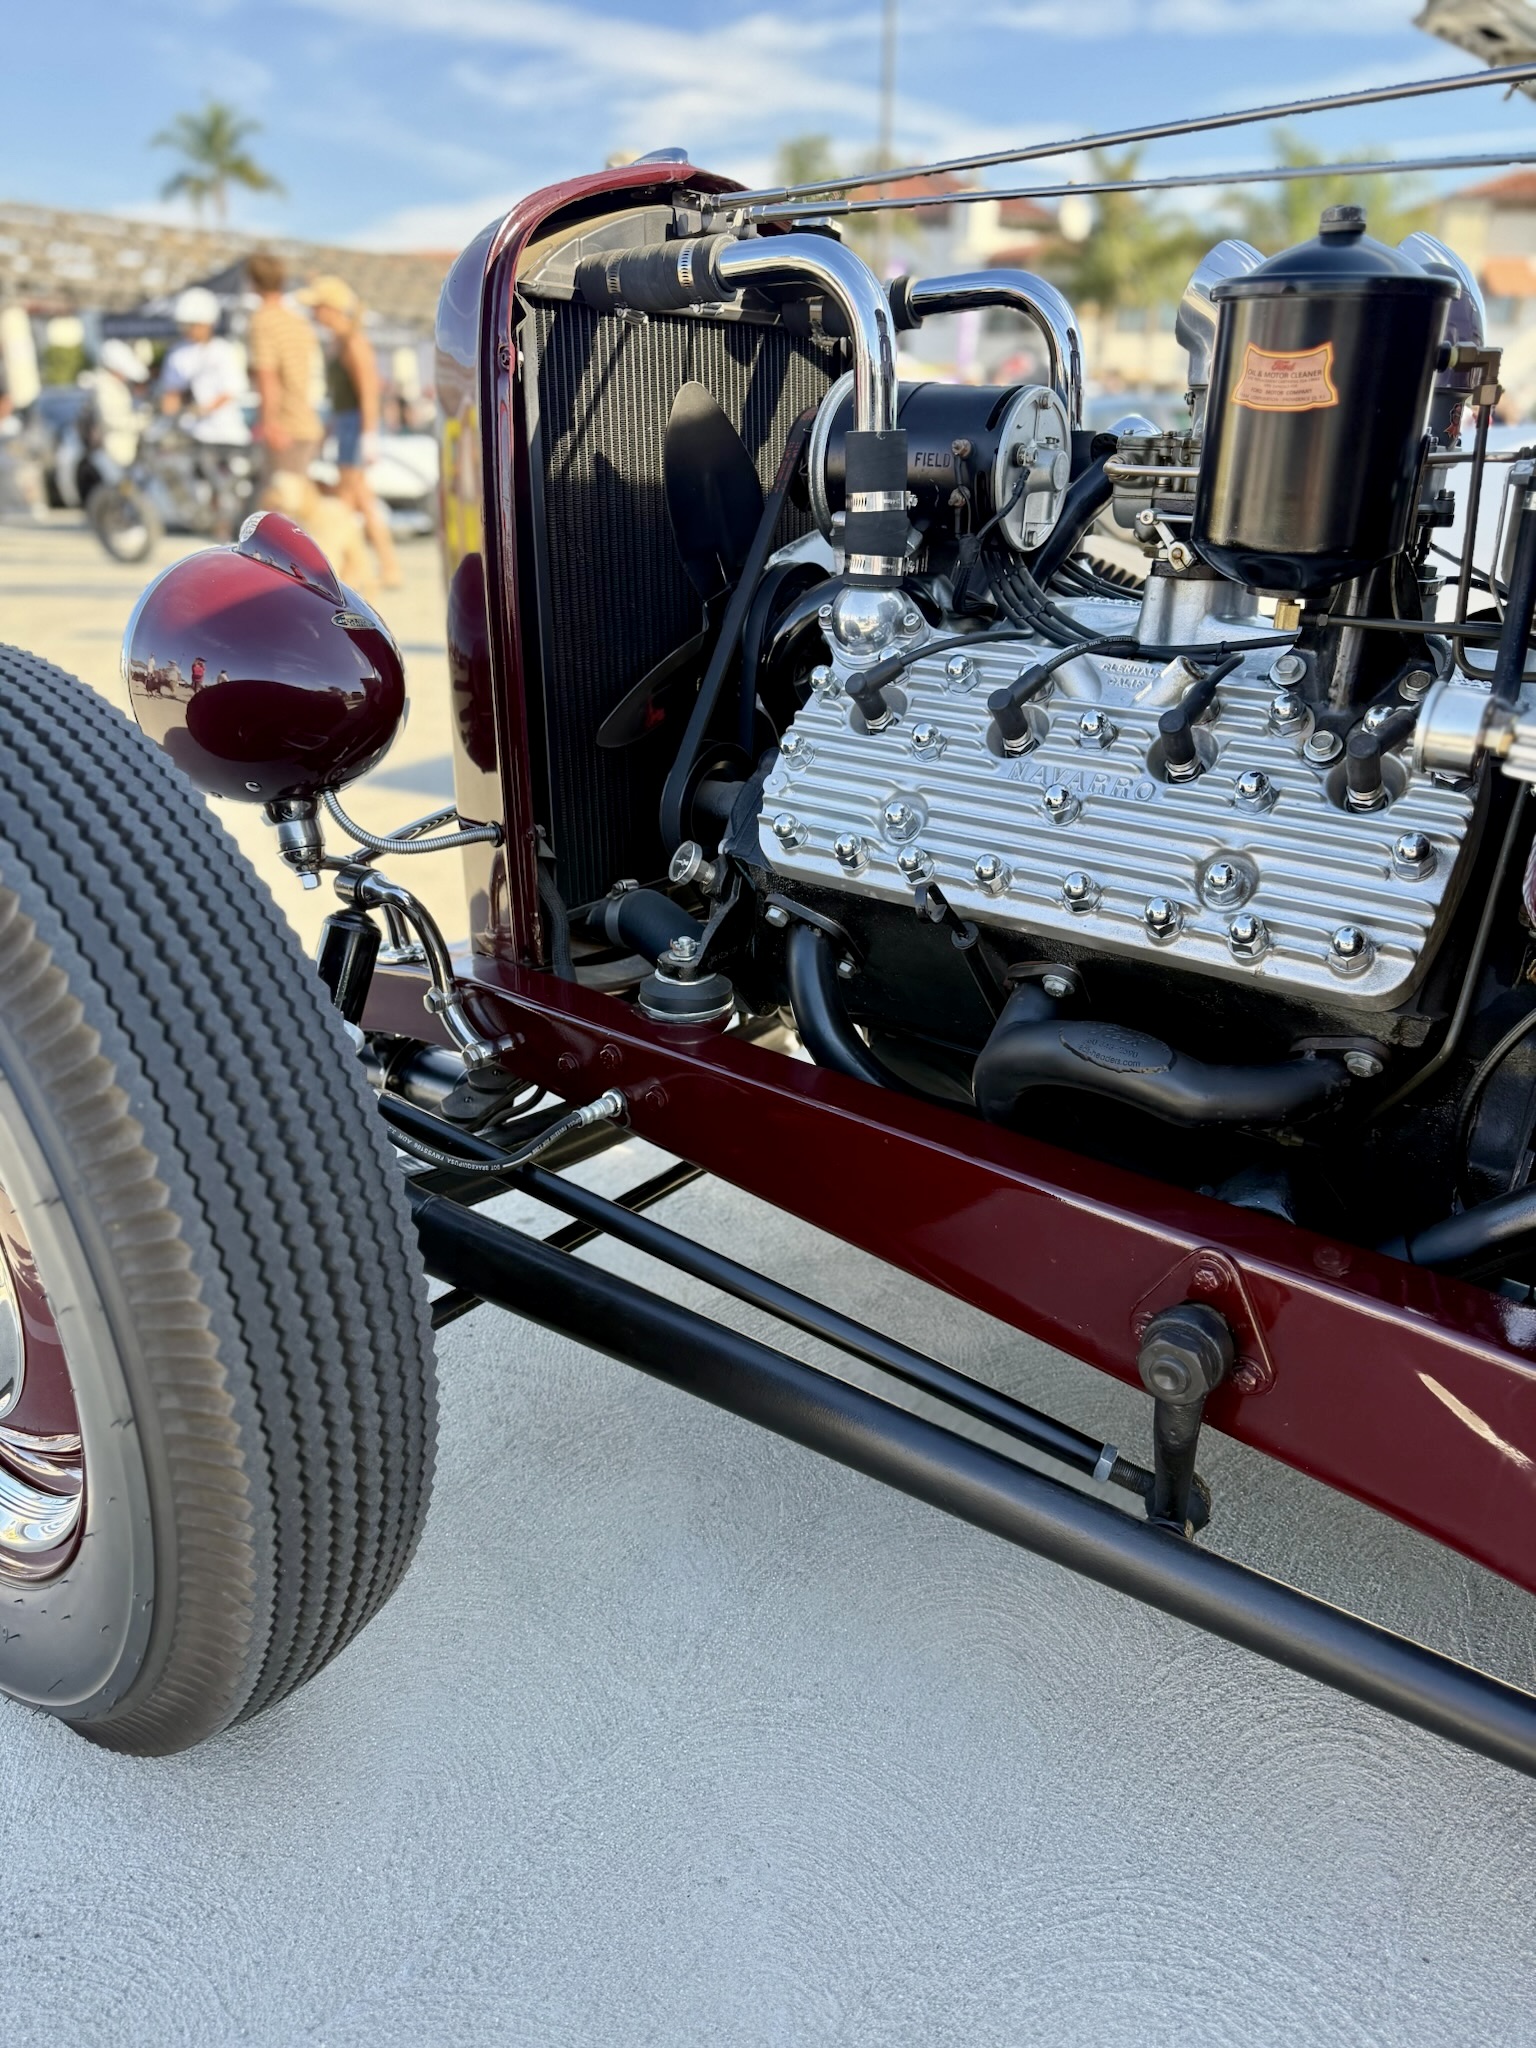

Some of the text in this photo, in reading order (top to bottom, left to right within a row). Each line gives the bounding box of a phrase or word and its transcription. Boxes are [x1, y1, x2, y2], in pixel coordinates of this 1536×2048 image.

[1271, 360, 1296, 371] Ford
[1264, 371, 1288, 379] MOTOR
[1291, 369, 1322, 378] CLEANER
[914, 452, 951, 468] FIELD
[1008, 761, 1156, 801] NAVARRO
